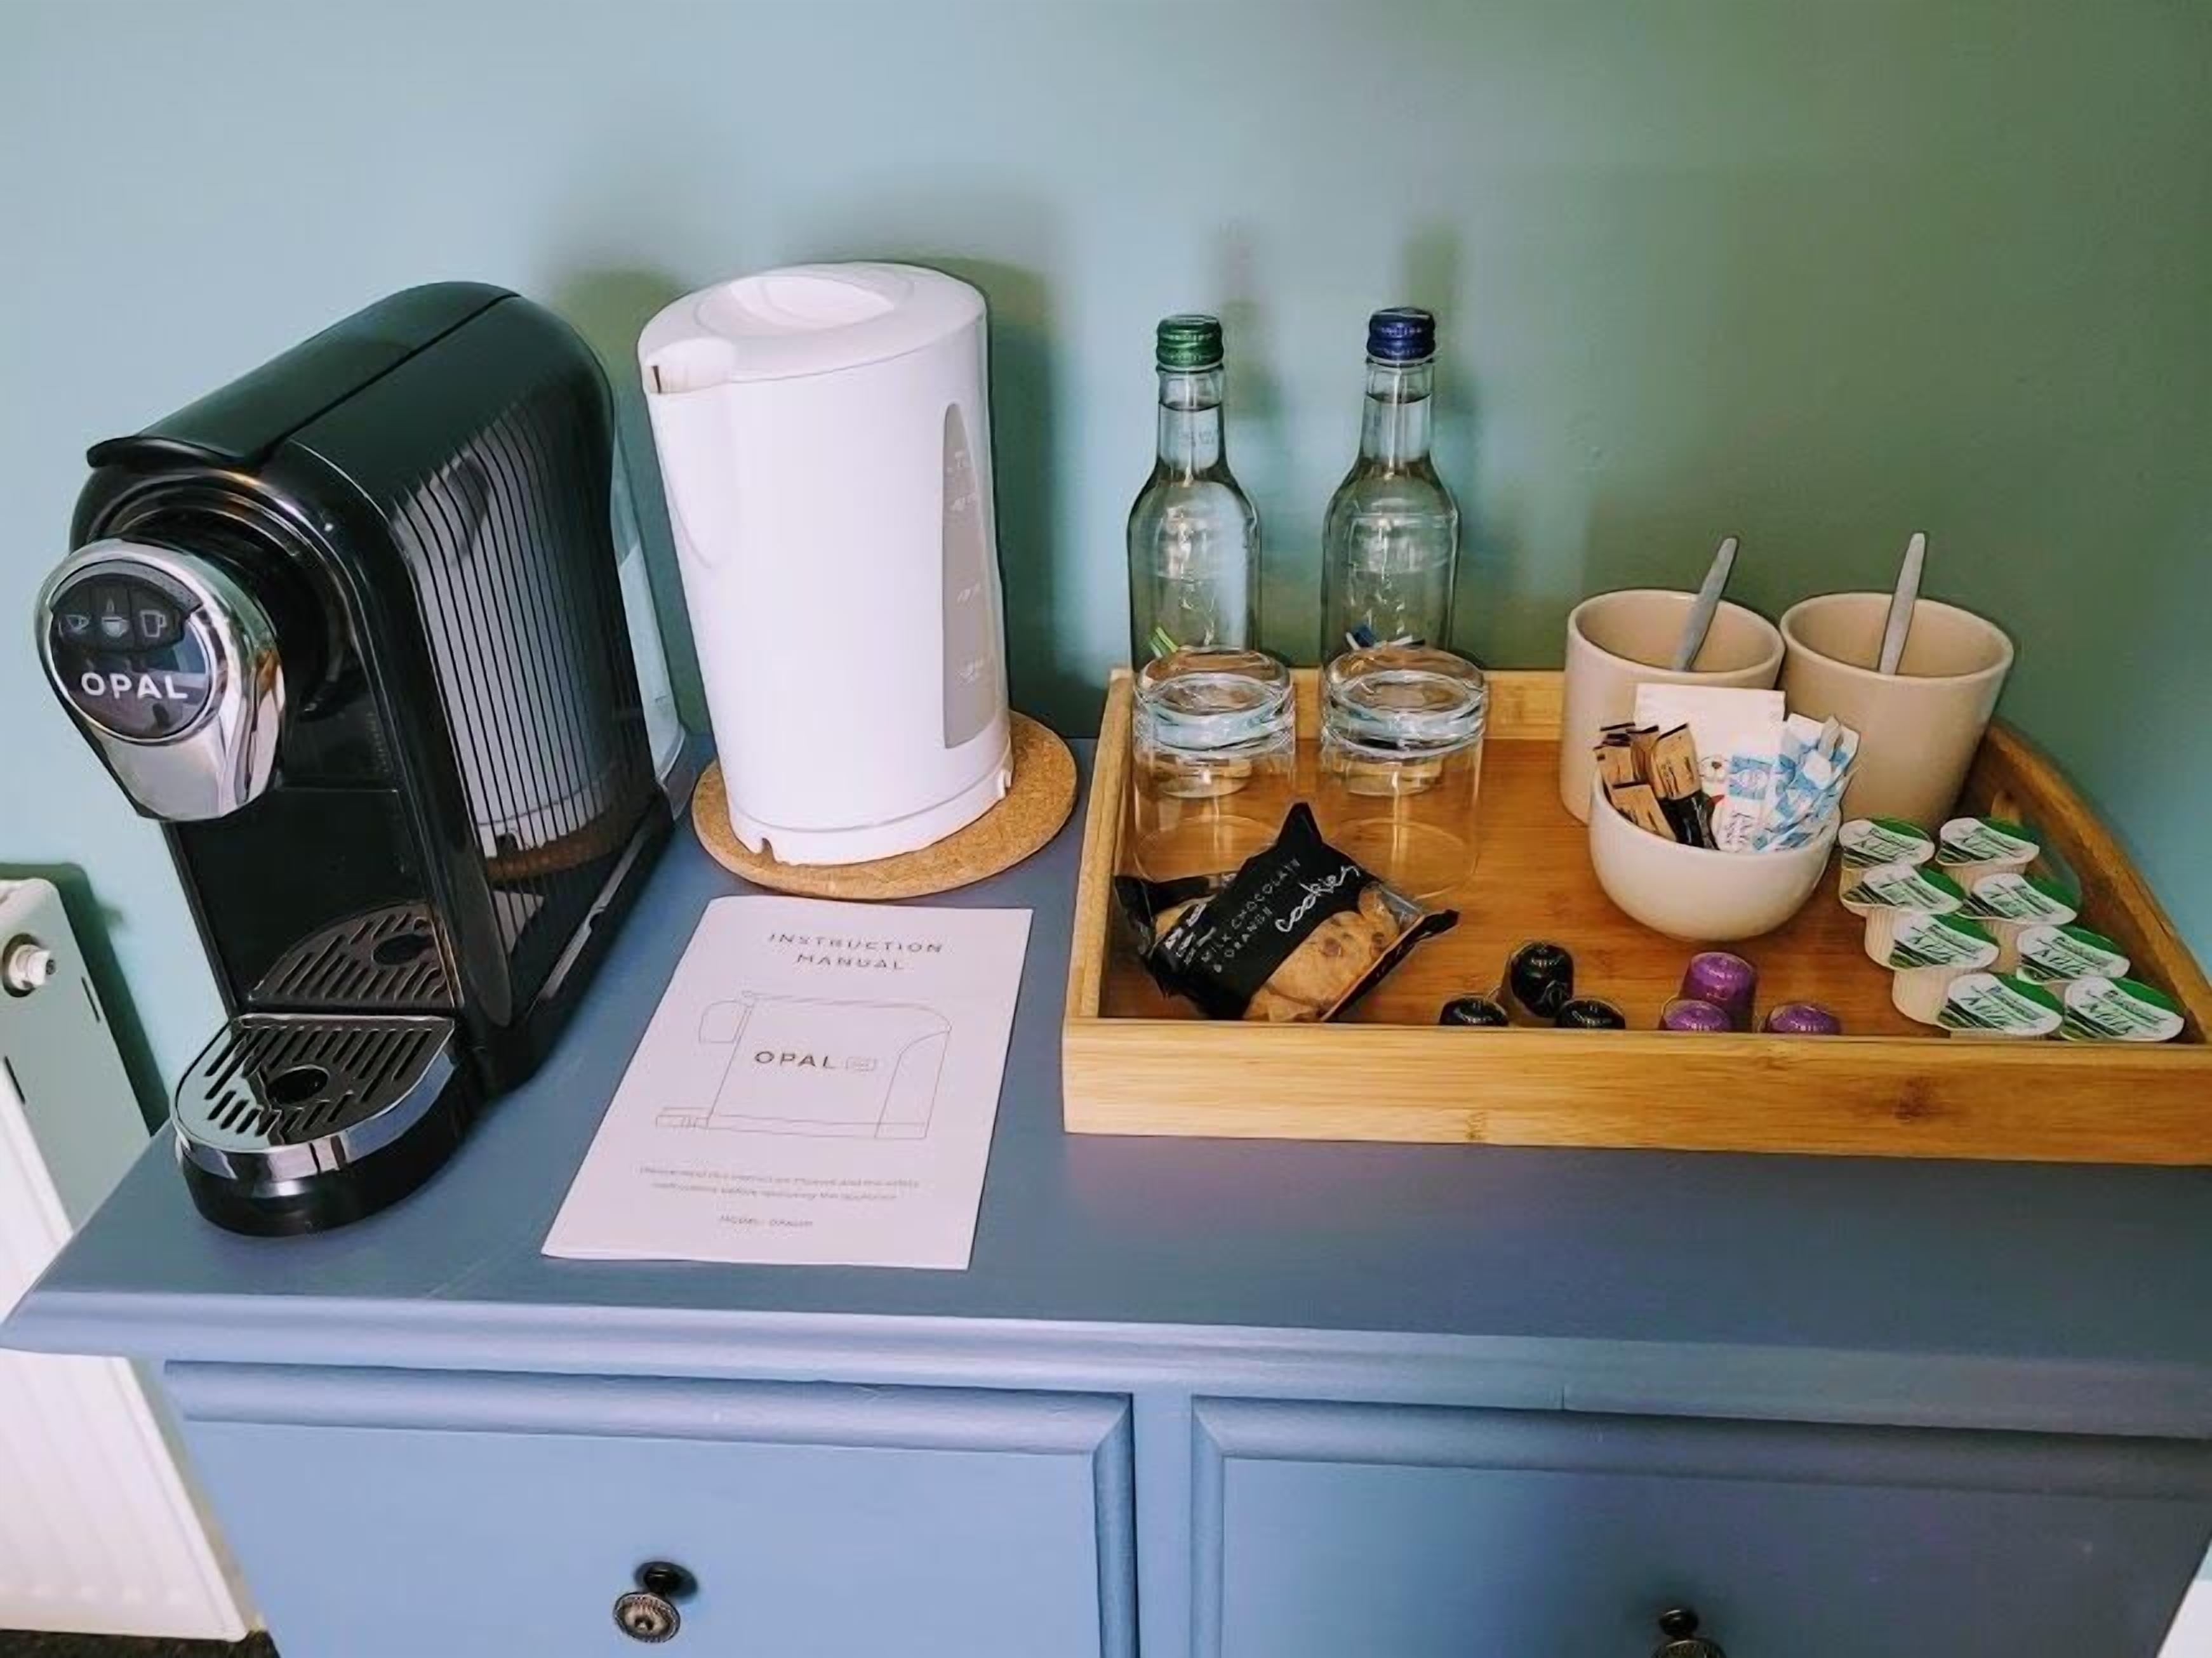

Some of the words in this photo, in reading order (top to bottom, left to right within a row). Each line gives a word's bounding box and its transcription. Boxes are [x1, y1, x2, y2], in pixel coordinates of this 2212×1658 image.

[81, 672, 188, 700] OPAL
[768, 933, 943, 954] INSTRUCTION
[796, 953, 905, 971] MANUAL
[754, 1050, 837, 1070] OPAL
